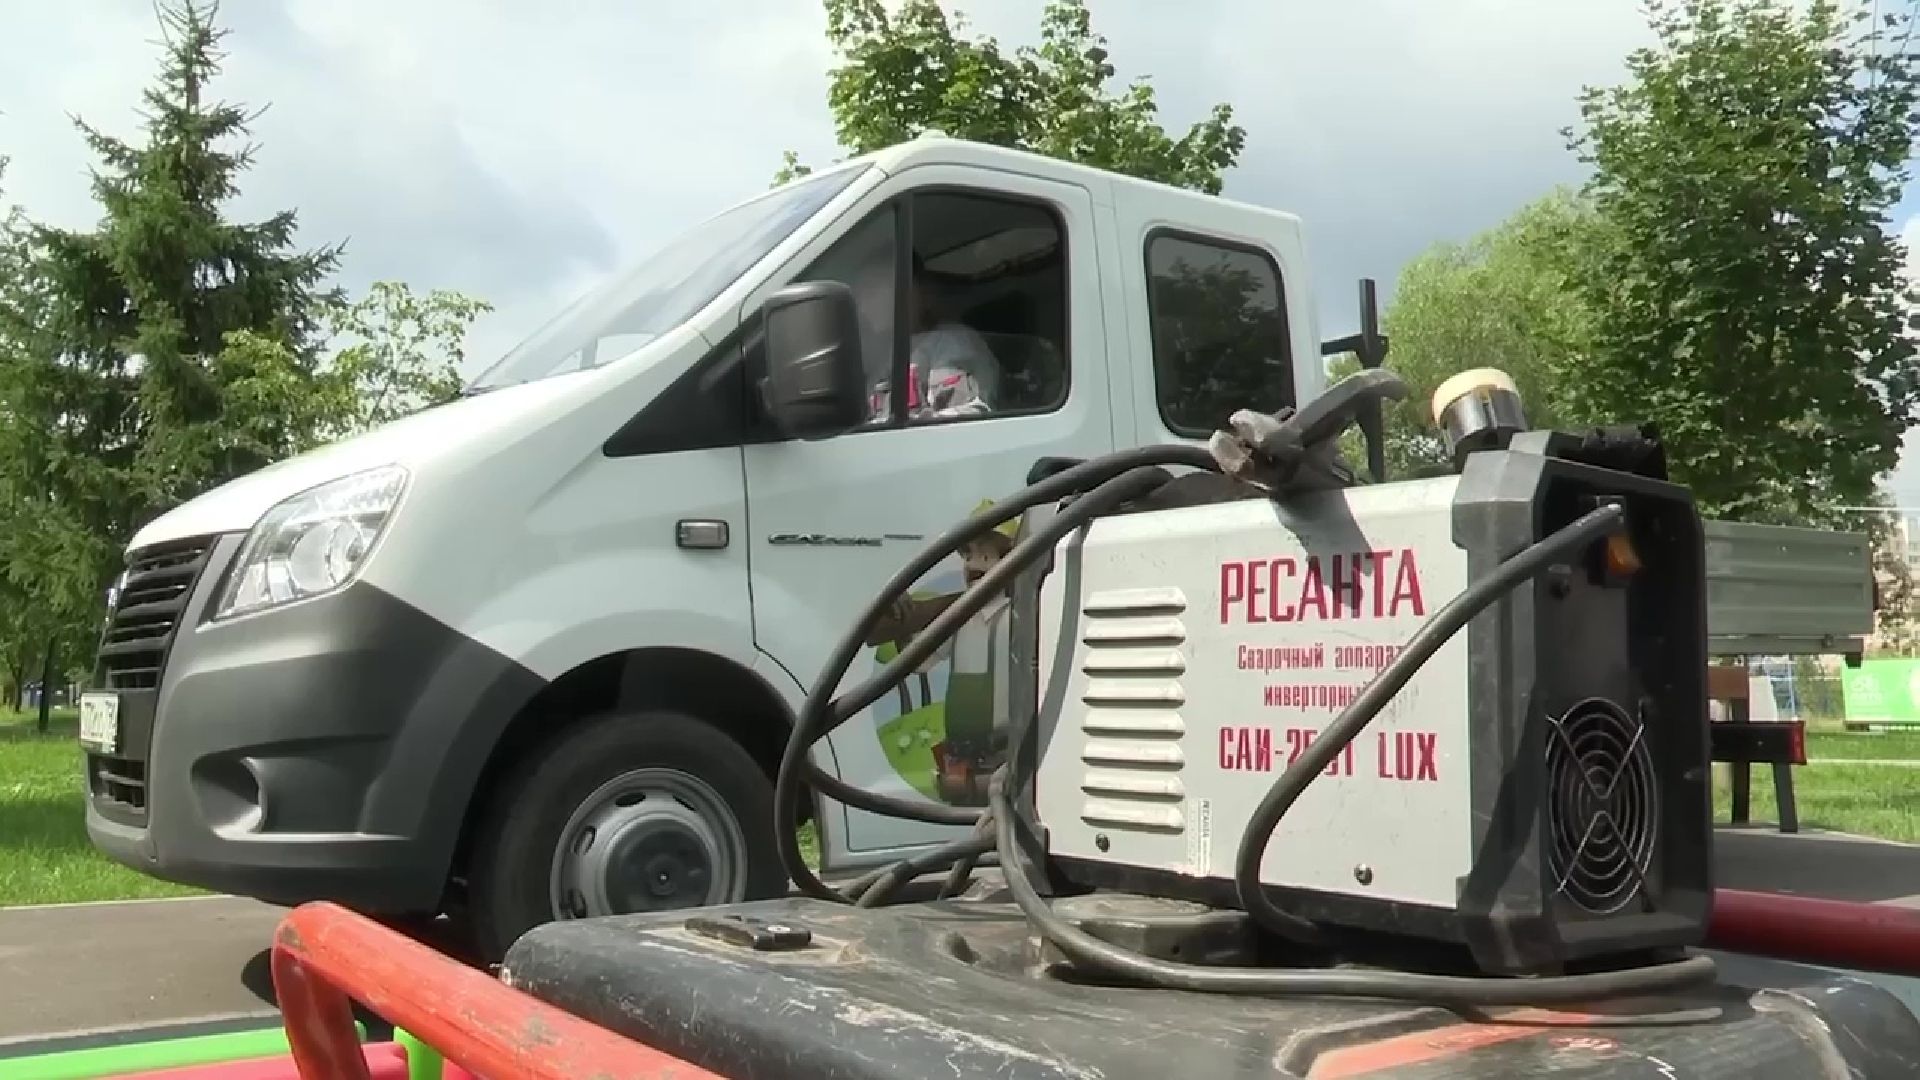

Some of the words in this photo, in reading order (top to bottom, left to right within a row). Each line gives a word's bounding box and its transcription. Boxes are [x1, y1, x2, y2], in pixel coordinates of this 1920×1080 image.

[1220, 549, 1425, 624] РЕСАНТА
[1238, 643, 1324, 675] Сварочный
[1264, 681, 1367, 712] инверторны
[1378, 731, 1438, 781] LUX
